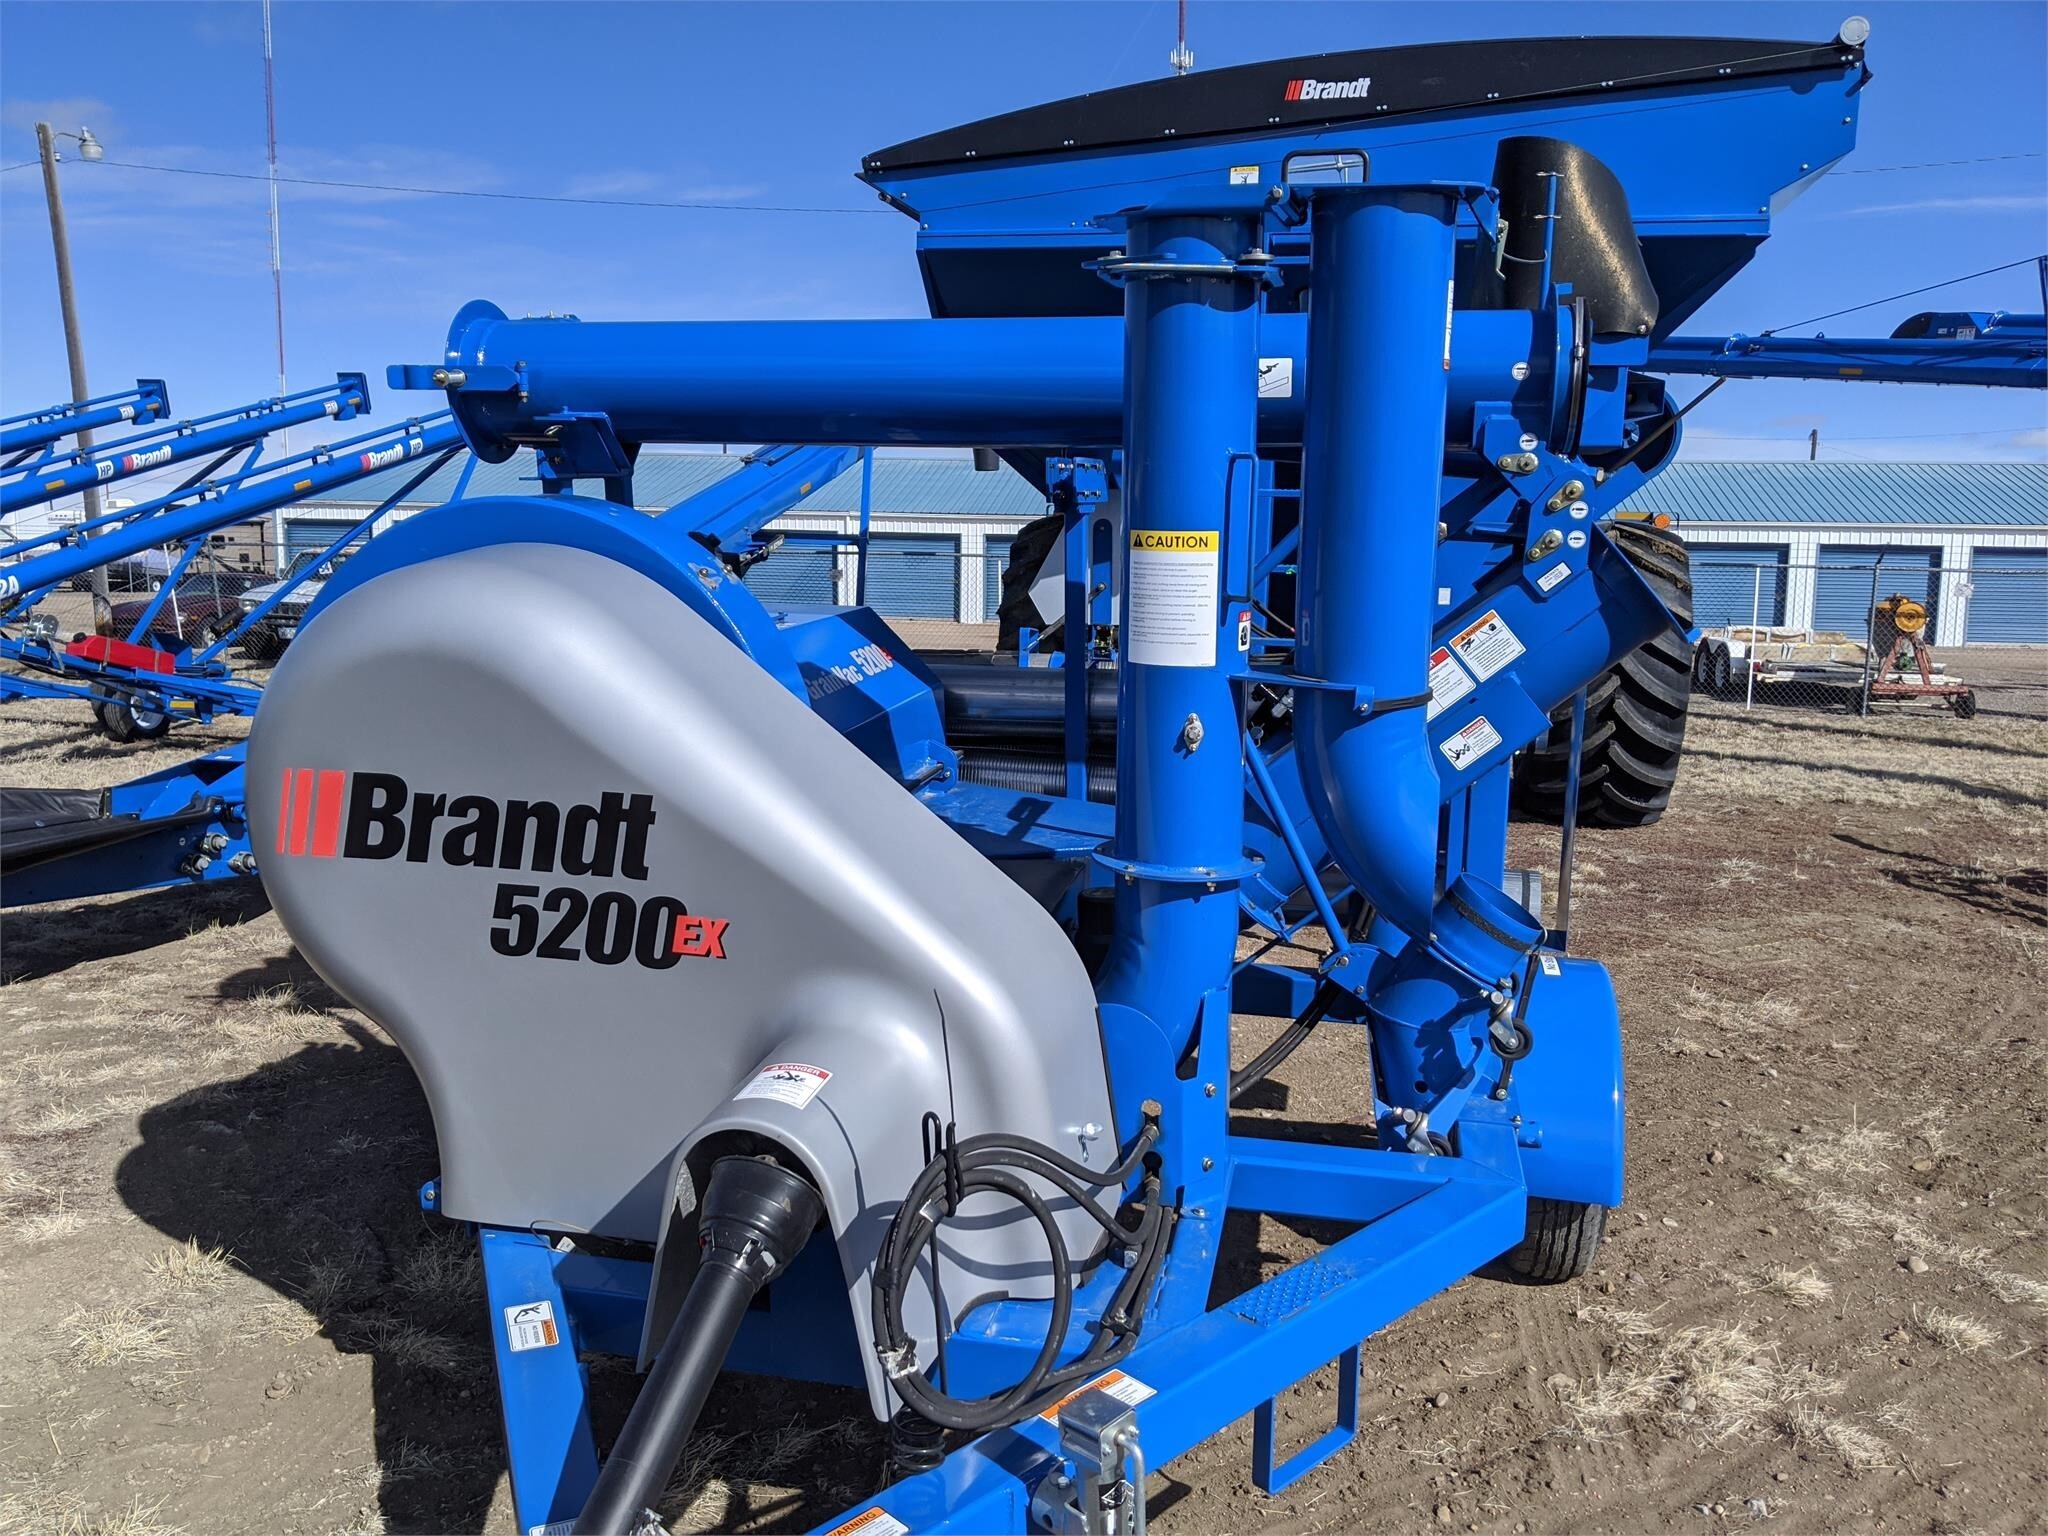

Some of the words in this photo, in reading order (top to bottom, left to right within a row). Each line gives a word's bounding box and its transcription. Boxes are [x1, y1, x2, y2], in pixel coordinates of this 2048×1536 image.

[1300, 77, 1371, 100] Brandt
[1145, 534, 1209, 548] CAUTION
[343, 771, 657, 881] Brandt
[780, 1064, 821, 1077] DANGER
